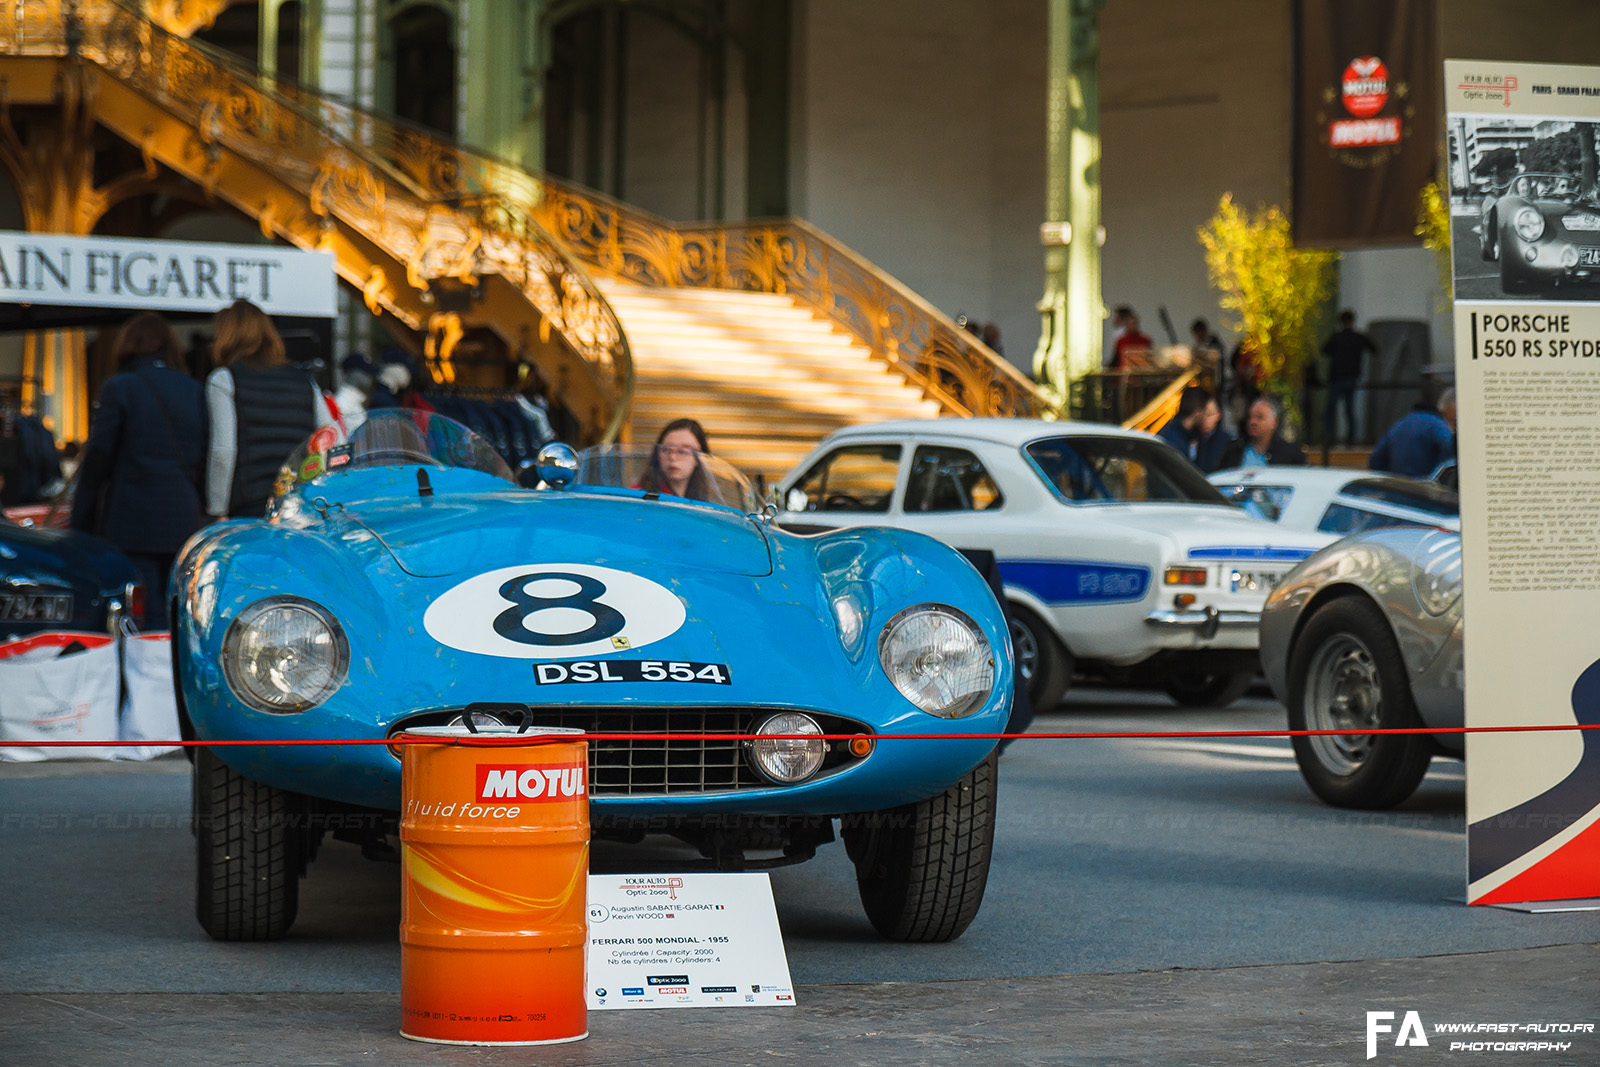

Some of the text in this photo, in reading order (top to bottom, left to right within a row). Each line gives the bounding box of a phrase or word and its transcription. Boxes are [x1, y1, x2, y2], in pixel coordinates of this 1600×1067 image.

[1532, 85, 1552, 95] PARIS
[86, 250, 281, 301] FIGARET
[1483, 315, 1570, 333] PORSCHE
[1483, 340, 1516, 358] 550
[1523, 340, 1543, 358] RS
[493, 572, 626, 646] 8
[537, 662, 726, 684] DSL 554
[482, 769, 585, 798] MOTUL
[406, 799, 521, 819] fluid force
[612, 950, 649, 958] Cylindrée
[656, 949, 692, 957] Capacity:
[633, 957, 669, 966] cylindres
[675, 956, 714, 964] Cylinders:
